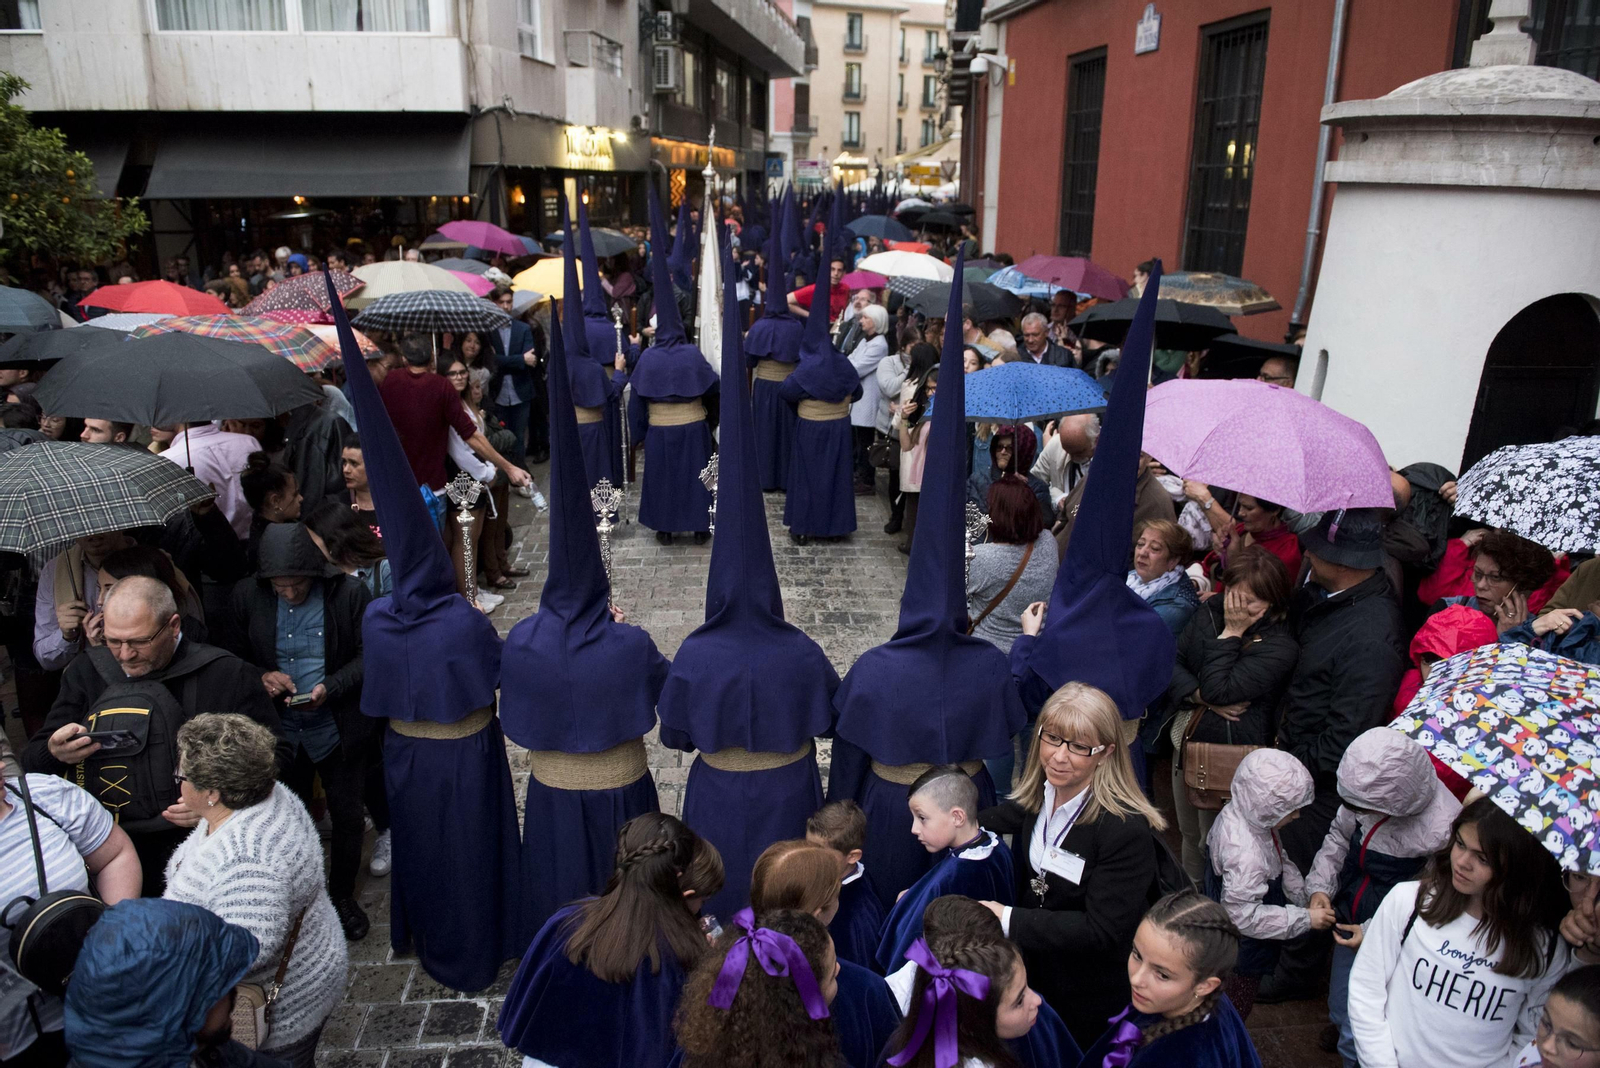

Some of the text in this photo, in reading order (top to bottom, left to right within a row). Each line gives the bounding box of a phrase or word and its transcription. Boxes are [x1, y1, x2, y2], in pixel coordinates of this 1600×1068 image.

[76, 759, 85, 789] NISTA
[1436, 940, 1499, 970] bonjou
[1412, 957, 1517, 1021] CHÉRIE
